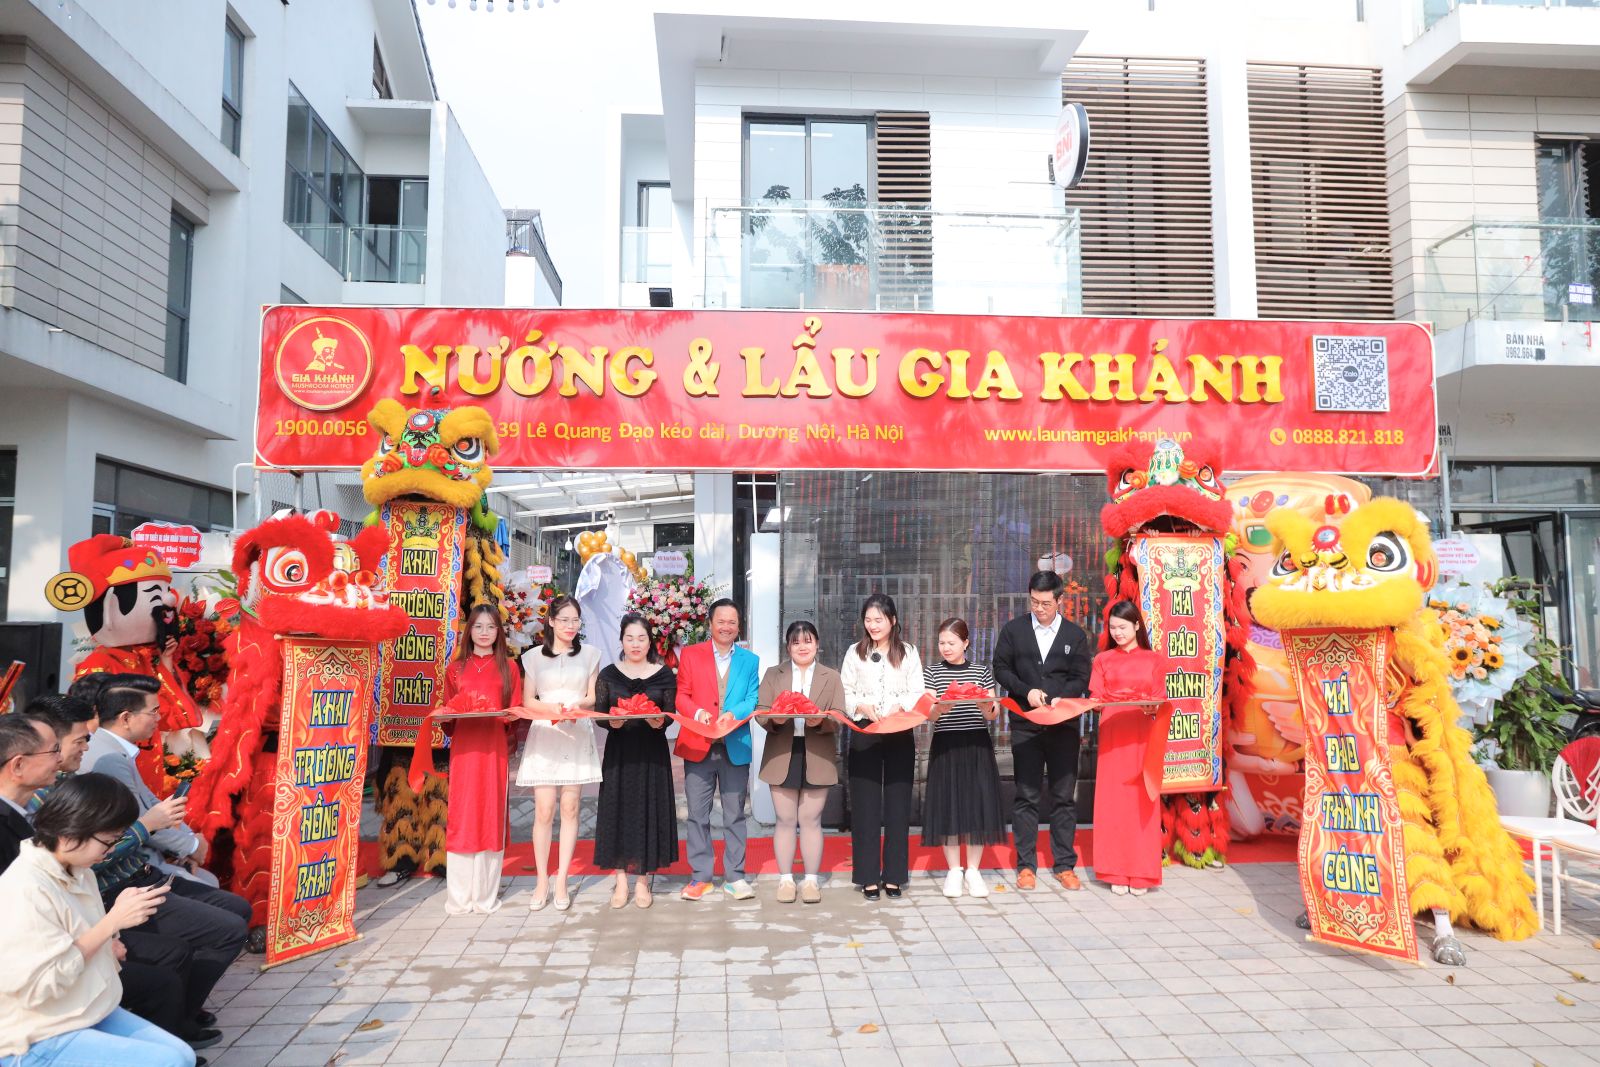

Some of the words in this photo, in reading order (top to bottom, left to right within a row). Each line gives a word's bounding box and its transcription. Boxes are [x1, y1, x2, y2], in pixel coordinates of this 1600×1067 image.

[291, 373, 311, 383] GIA
[314, 372, 355, 383] KHÁNH
[400, 329, 657, 397] NƯỚNG
[683, 338, 720, 398] &
[740, 316, 880, 398] LẨU
[898, 348, 1023, 400] GIA
[1039, 338, 1285, 404] KHÁNH
[275, 419, 367, 436] 1900.0056
[527, 422, 547, 438] Lê
[554, 422, 611, 442] Quang
[619, 422, 655, 443] Đạo
[660, 421, 693, 439] kéo
[699, 423, 730, 441] dài,
[739, 423, 798, 442] Dương
[806, 423, 842, 443] Nội,
[847, 424, 869, 440] Hà
[875, 424, 904, 442] Nội
[1293, 429, 1404, 446] 0888.821.818
[402, 549, 437, 575] KHAI
[395, 625, 435, 661] HỒNG
[1168, 625, 1198, 657] ĐÁO
[394, 674, 432, 704] PHÁT
[309, 690, 354, 727] KHAI
[294, 743, 356, 787] TRƯƠNG
[1325, 728, 1360, 773] ĐÁO
[299, 791, 340, 844] HỒNG
[1322, 786, 1382, 834] THÀNH
[294, 852, 337, 903] PHÁT
[1322, 845, 1381, 895] CÔNG
